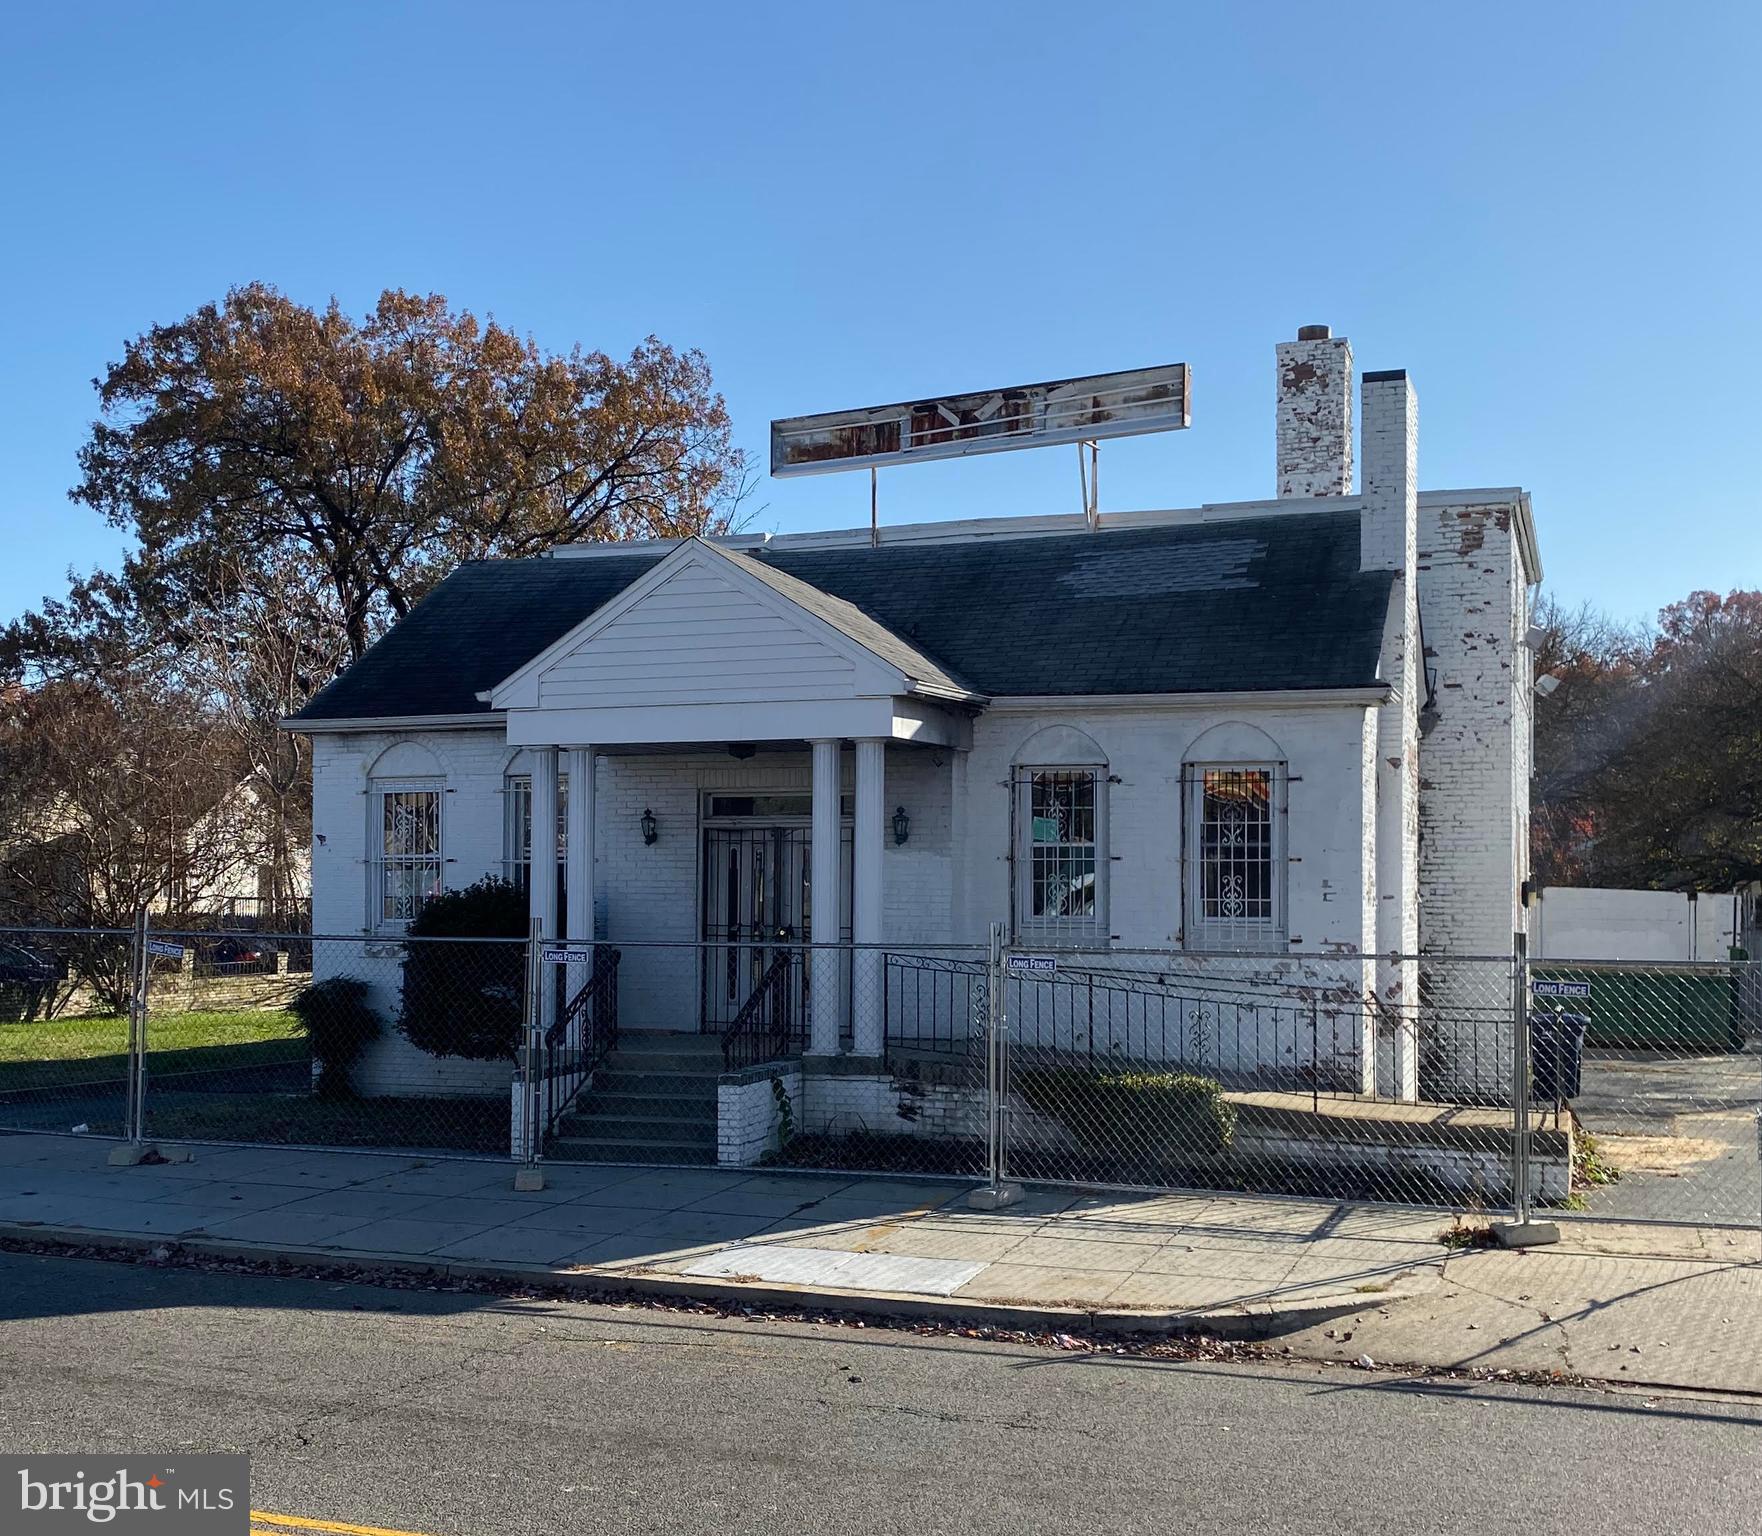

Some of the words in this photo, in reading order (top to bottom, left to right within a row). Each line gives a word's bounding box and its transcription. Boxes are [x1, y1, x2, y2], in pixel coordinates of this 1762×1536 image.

[545, 951, 563, 961] LONG
[564, 952, 586, 962] FENCE
[1009, 958, 1029, 968] LONG
[1030, 959, 1054, 970] FENCE
[1533, 982, 1557, 994] LONG
[1558, 983, 1587, 996] FENCE
